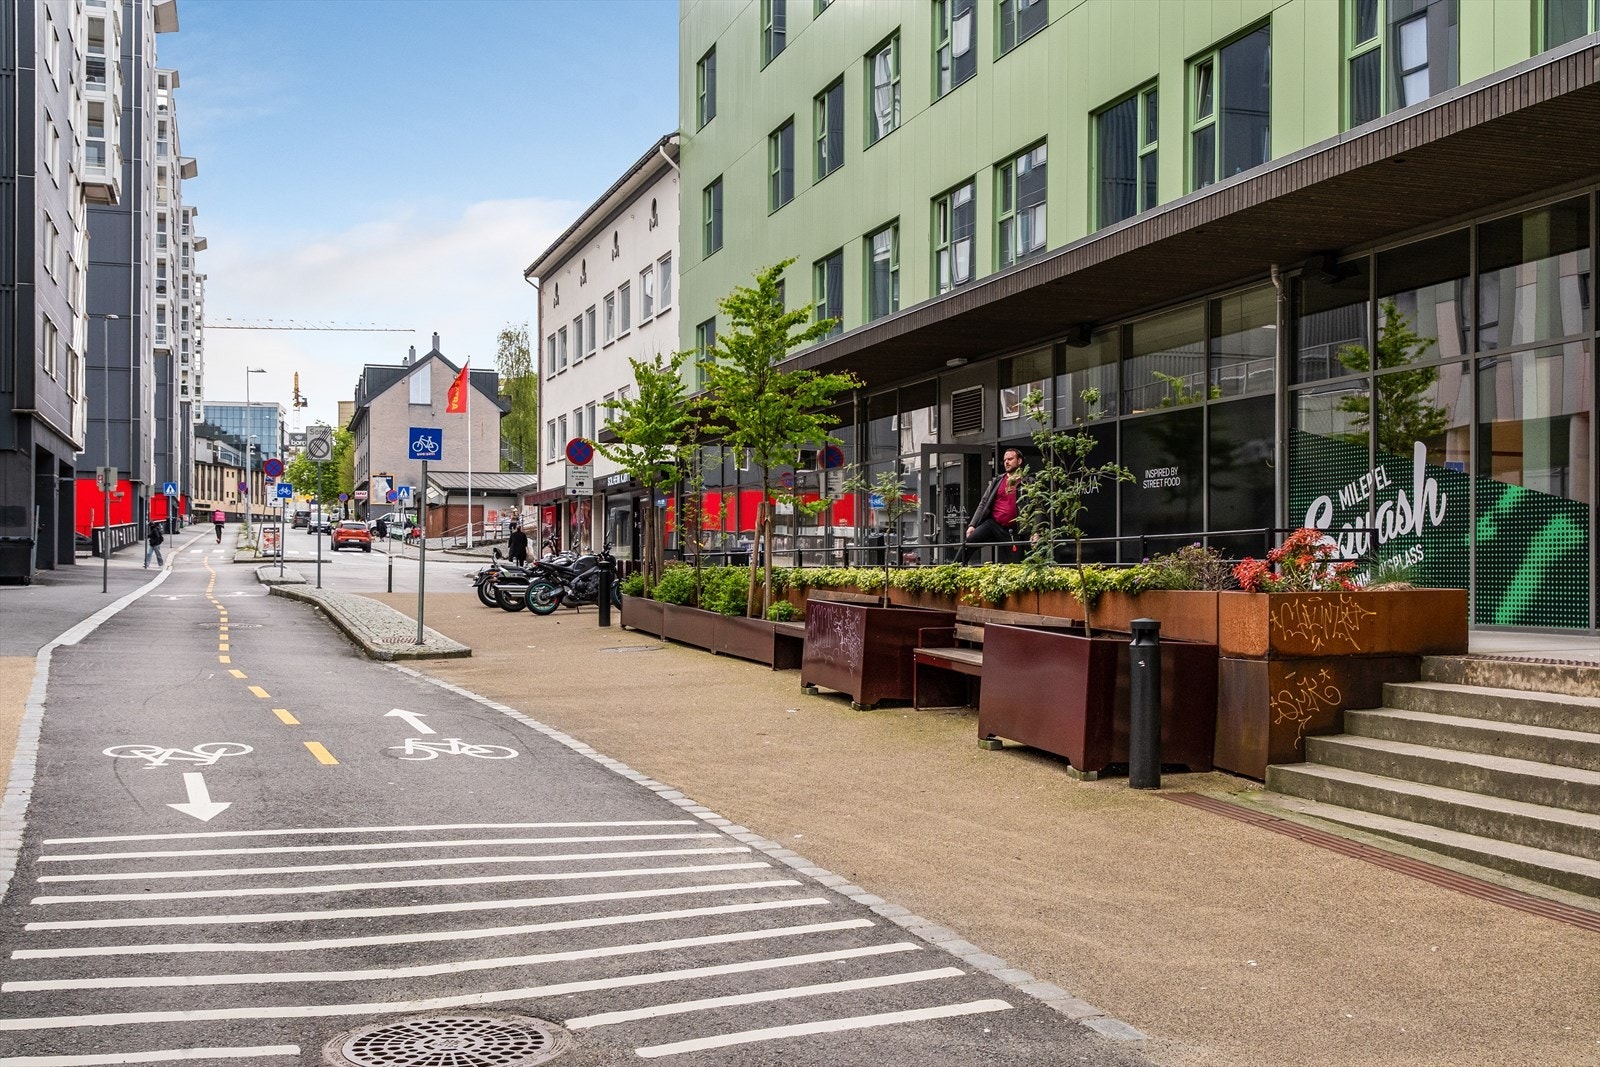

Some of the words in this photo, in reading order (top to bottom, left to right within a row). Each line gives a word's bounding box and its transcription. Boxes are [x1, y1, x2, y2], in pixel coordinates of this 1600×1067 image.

[1145, 468, 1170, 479] INSPIRED
[1170, 466, 1179, 476] BY
[1142, 479, 1163, 489] STREET
[1164, 476, 1181, 487] FOOD
[946, 505, 967, 513] JAJA
[1304, 440, 1446, 572] Squash
